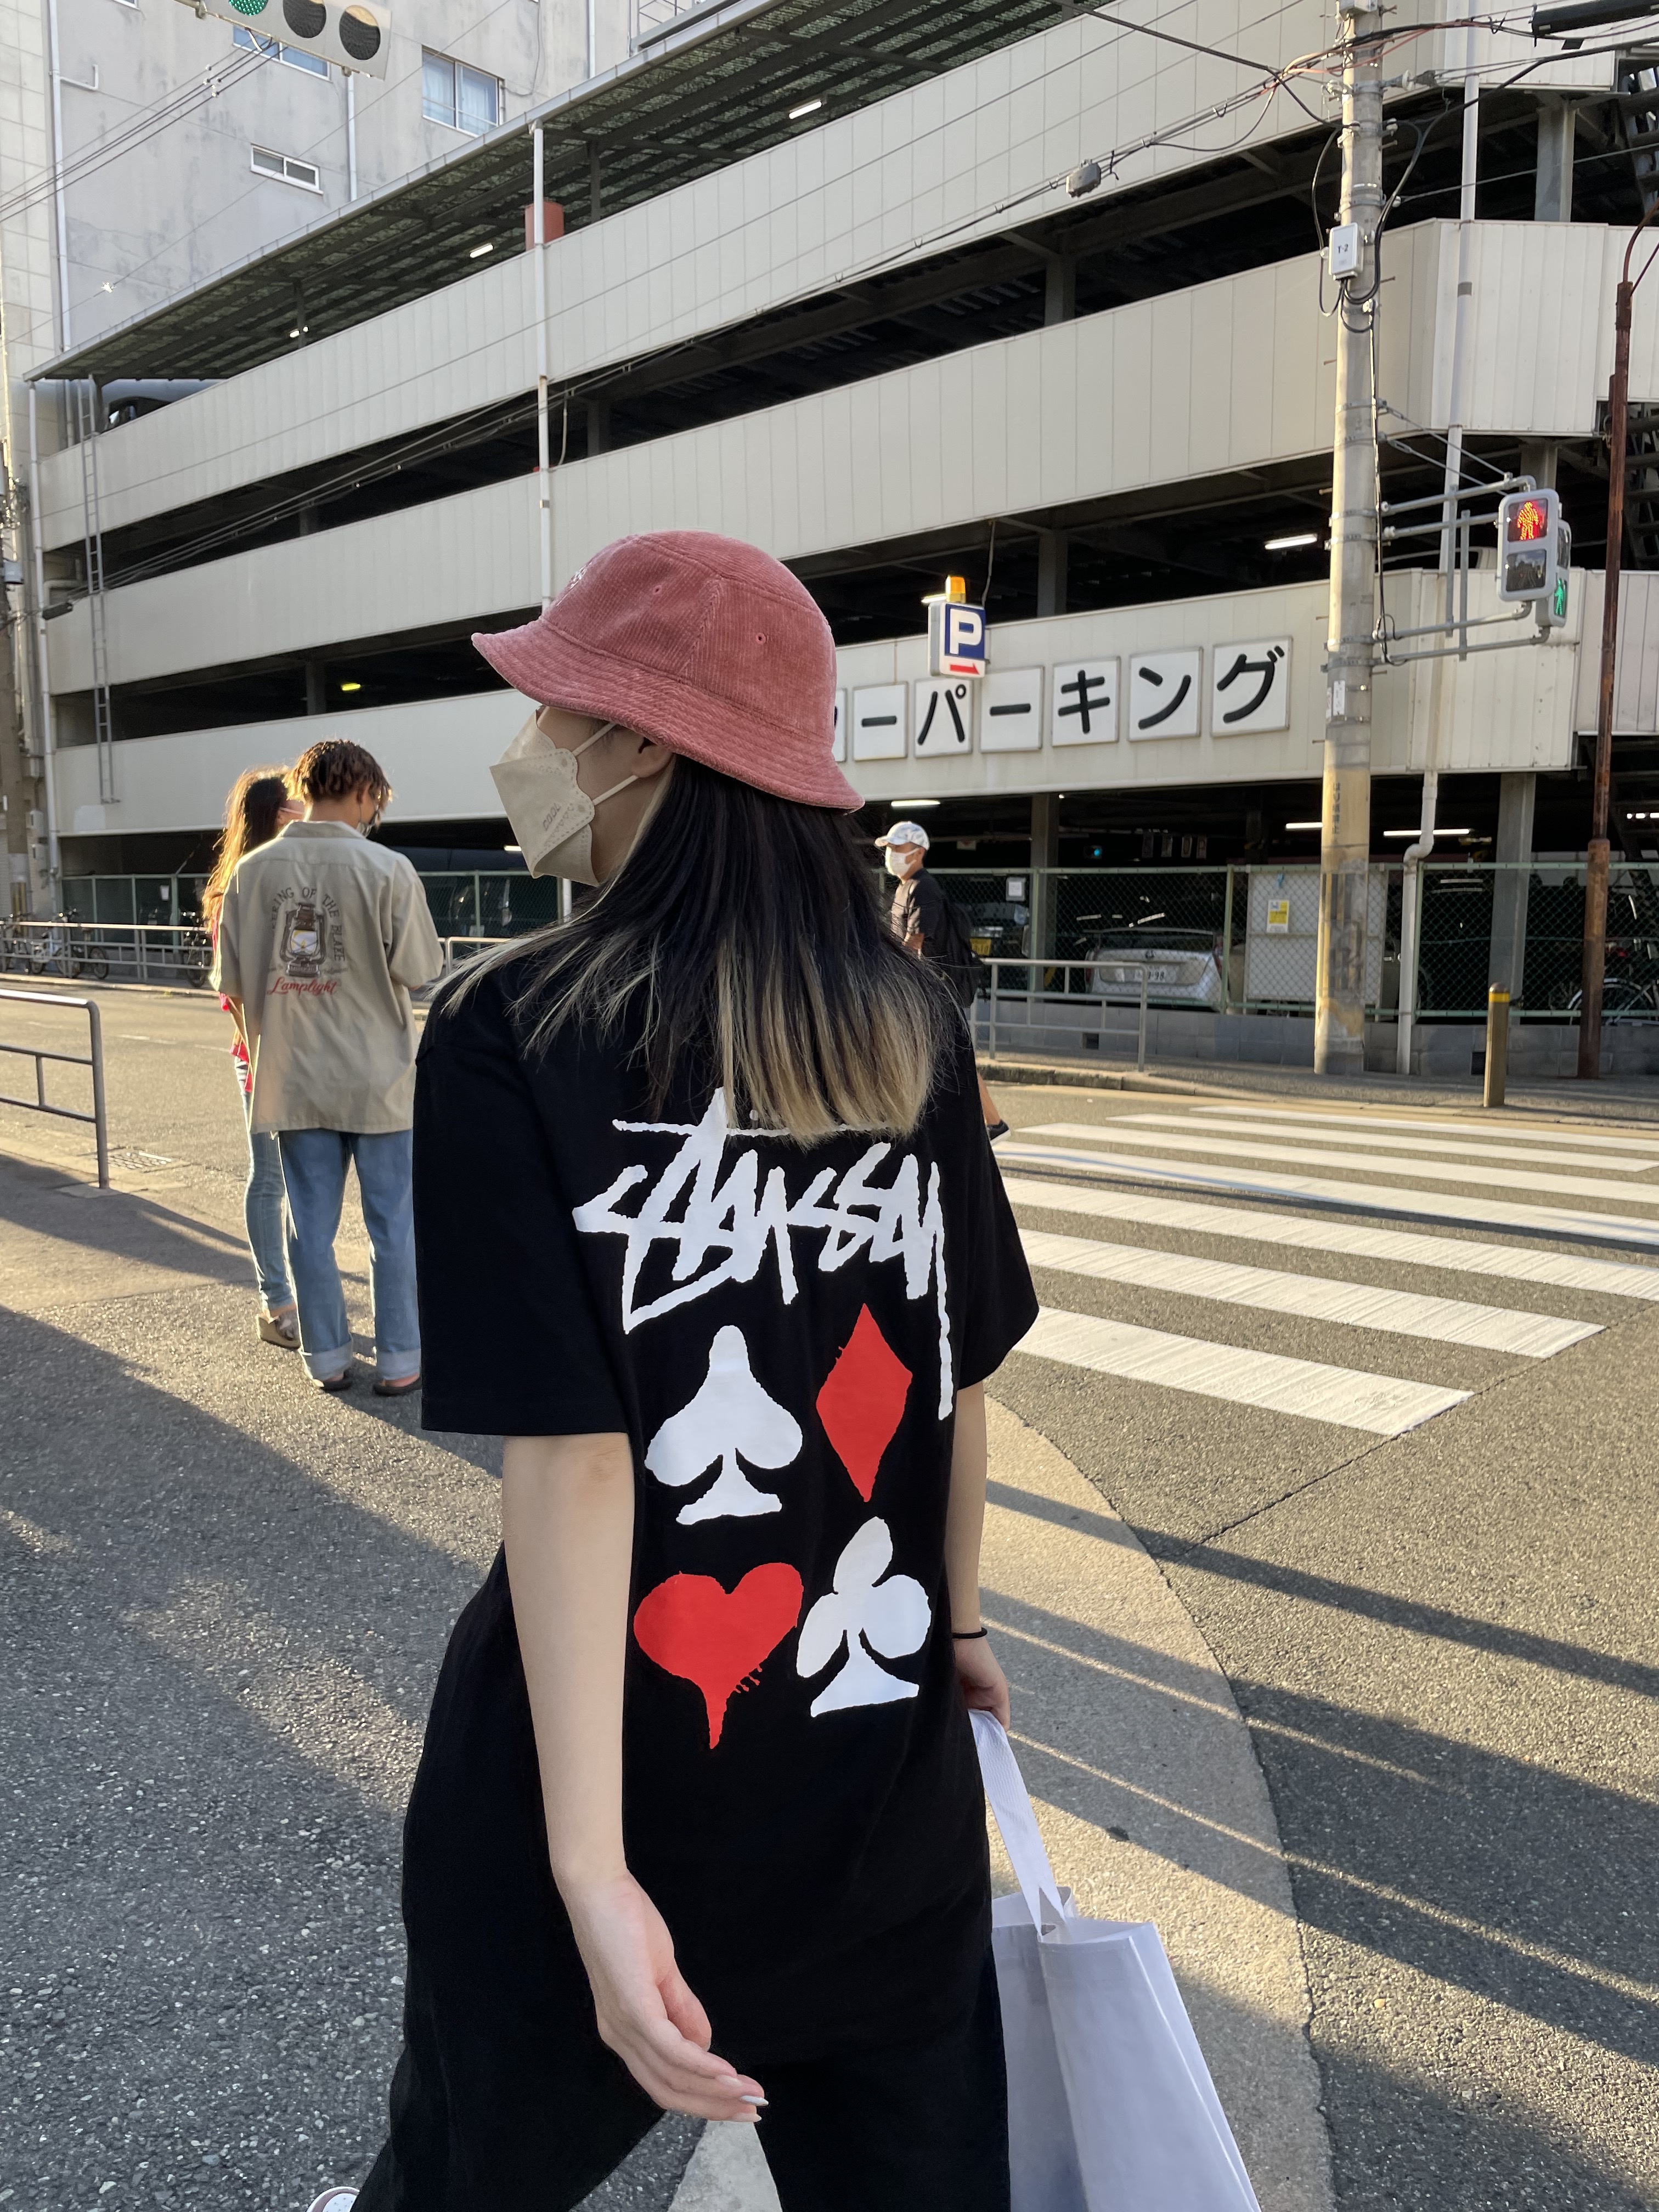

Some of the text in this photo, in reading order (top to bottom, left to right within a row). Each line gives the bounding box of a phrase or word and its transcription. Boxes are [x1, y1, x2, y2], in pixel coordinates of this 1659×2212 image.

[950, 608, 982, 655] P
[834, 645, 1285, 746] ーパーキング
[302, 887, 317, 898] OF
[323, 894, 340, 918] THE
[331, 924, 345, 961] BLAZE
[267, 977, 337, 996] Lamplight
